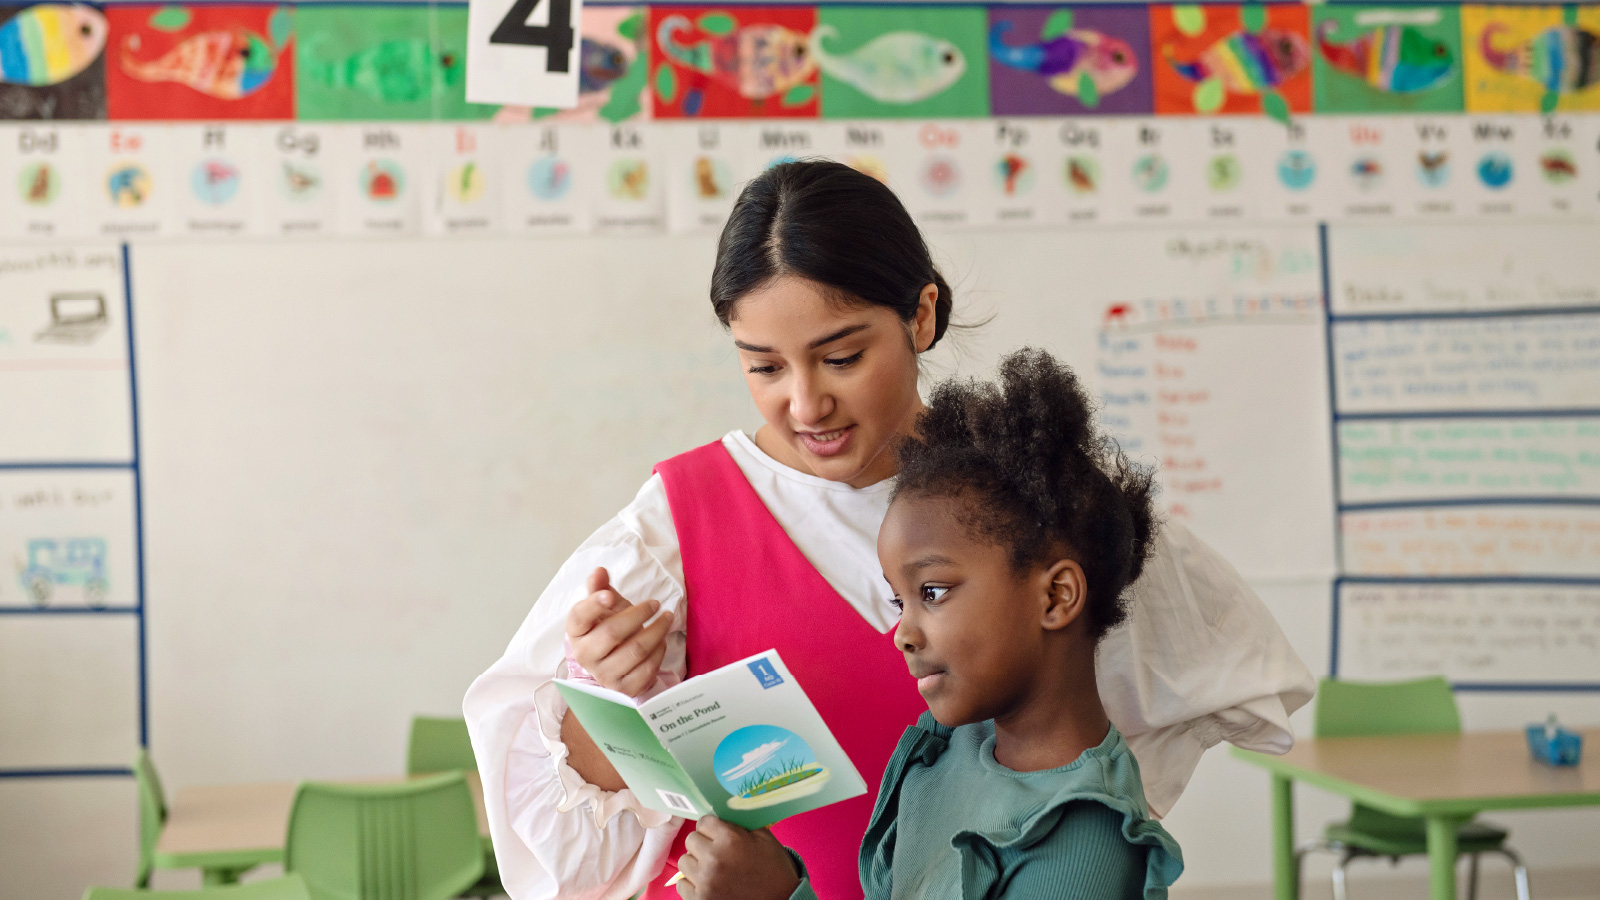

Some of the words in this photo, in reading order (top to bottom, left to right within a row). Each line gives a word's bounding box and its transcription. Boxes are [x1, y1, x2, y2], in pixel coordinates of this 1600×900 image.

[489, 0, 574, 73] 4
[18, 126, 59, 154] Dd
[110, 126, 143, 153] Ee
[276, 127, 321, 158] Gg
[918, 122, 960, 149] Oo
[758, 664, 769, 676] 1
[659, 722, 677, 733] On
[676, 714, 694, 726] the
[693, 700, 721, 718] Pond
